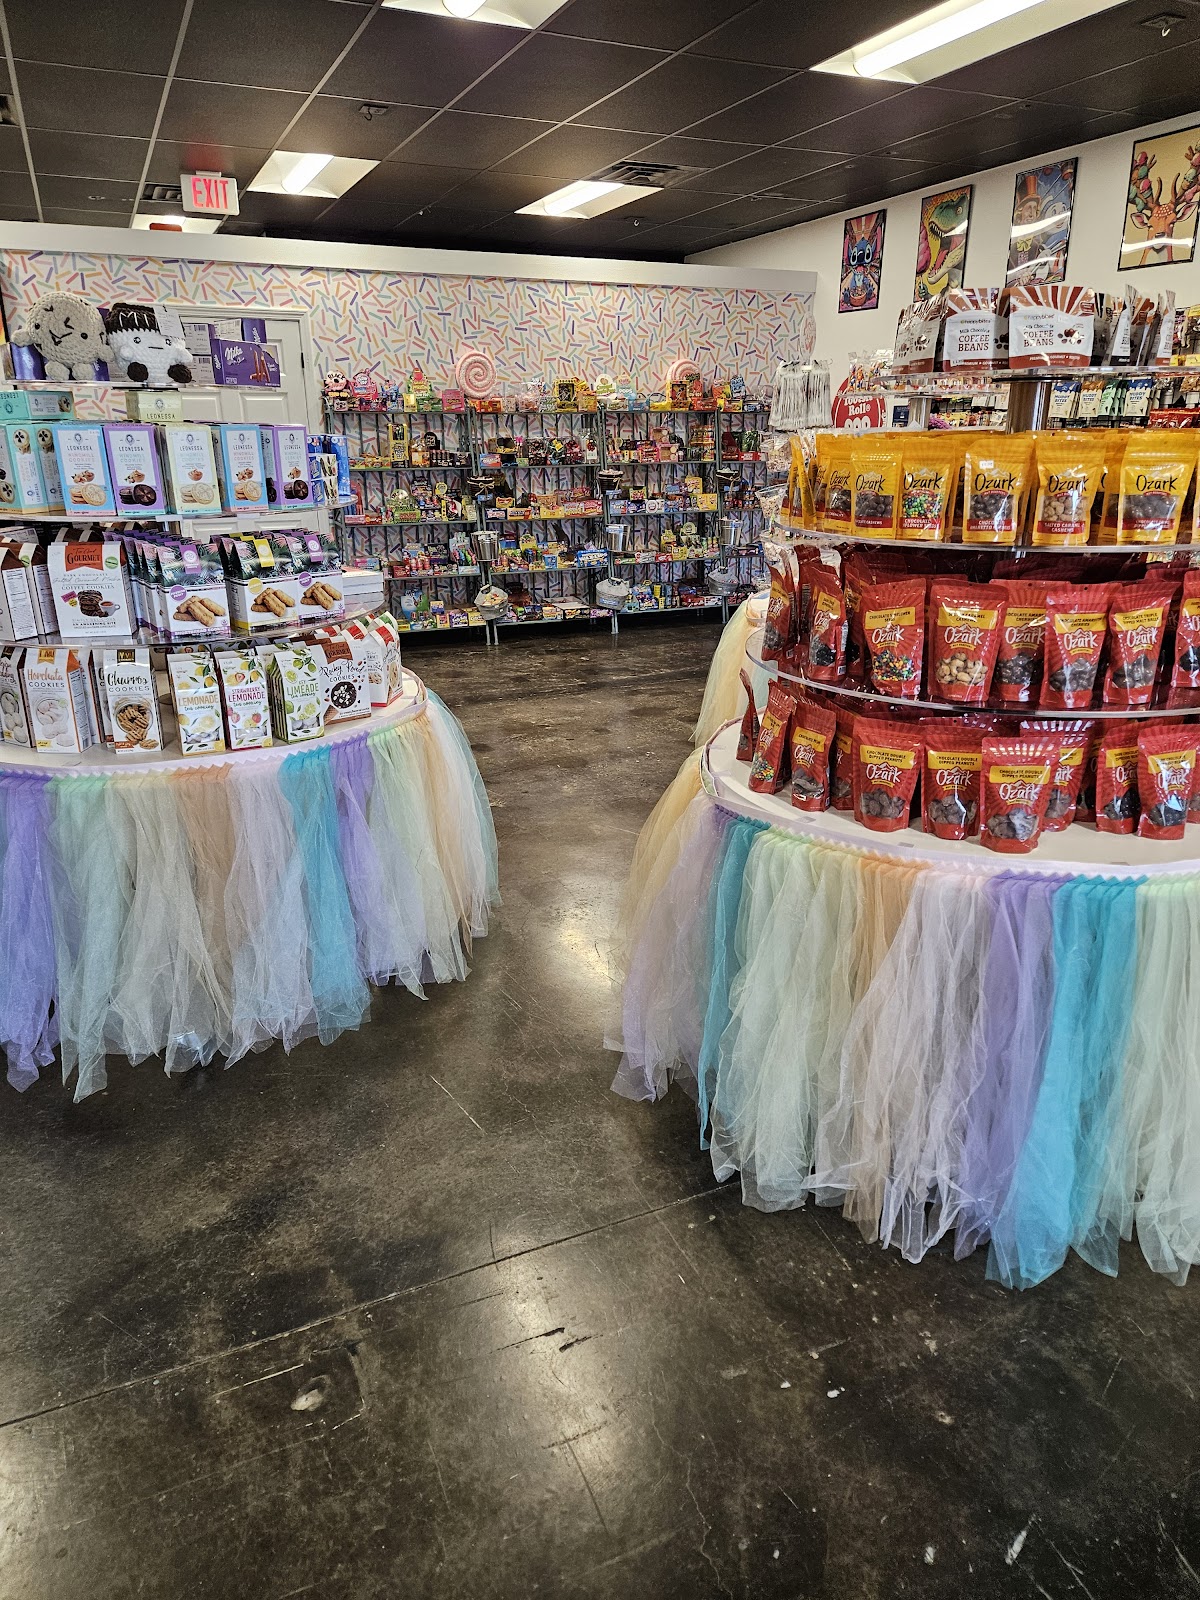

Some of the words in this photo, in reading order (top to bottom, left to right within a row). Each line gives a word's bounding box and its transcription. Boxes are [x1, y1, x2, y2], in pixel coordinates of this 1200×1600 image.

[192, 178, 229, 210] EXIT
[225, 345, 243, 361] Milka
[958, 343, 989, 352] BEANS
[856, 474, 886, 491] Ozark
[904, 472, 942, 490] Ozark
[975, 472, 1016, 492] Ozark
[1049, 475, 1089, 492] Ozark
[1136, 474, 1178, 491] Ozark
[67, 552, 101, 564] GOURMET
[871, 625, 905, 644] Ozark
[944, 626, 985, 646] Ozark
[1005, 627, 1046, 645] Ozark
[1063, 633, 1099, 650] Ozark
[1126, 629, 1158, 648] Ozark
[27, 668, 63, 681] Horchata
[107, 671, 148, 686] Churros
[329, 674, 355, 682] COOKIES
[228, 691, 266, 702] LEMONADE
[287, 682, 319, 695] LIMEADE
[178, 694, 219, 706] LEMONADE
[794, 744, 816, 764] Ozark
[866, 763, 902, 783] Ozark
[936, 769, 973, 786] Ozark
[1054, 765, 1074, 782] ark
[999, 782, 1041, 801] Ozark
